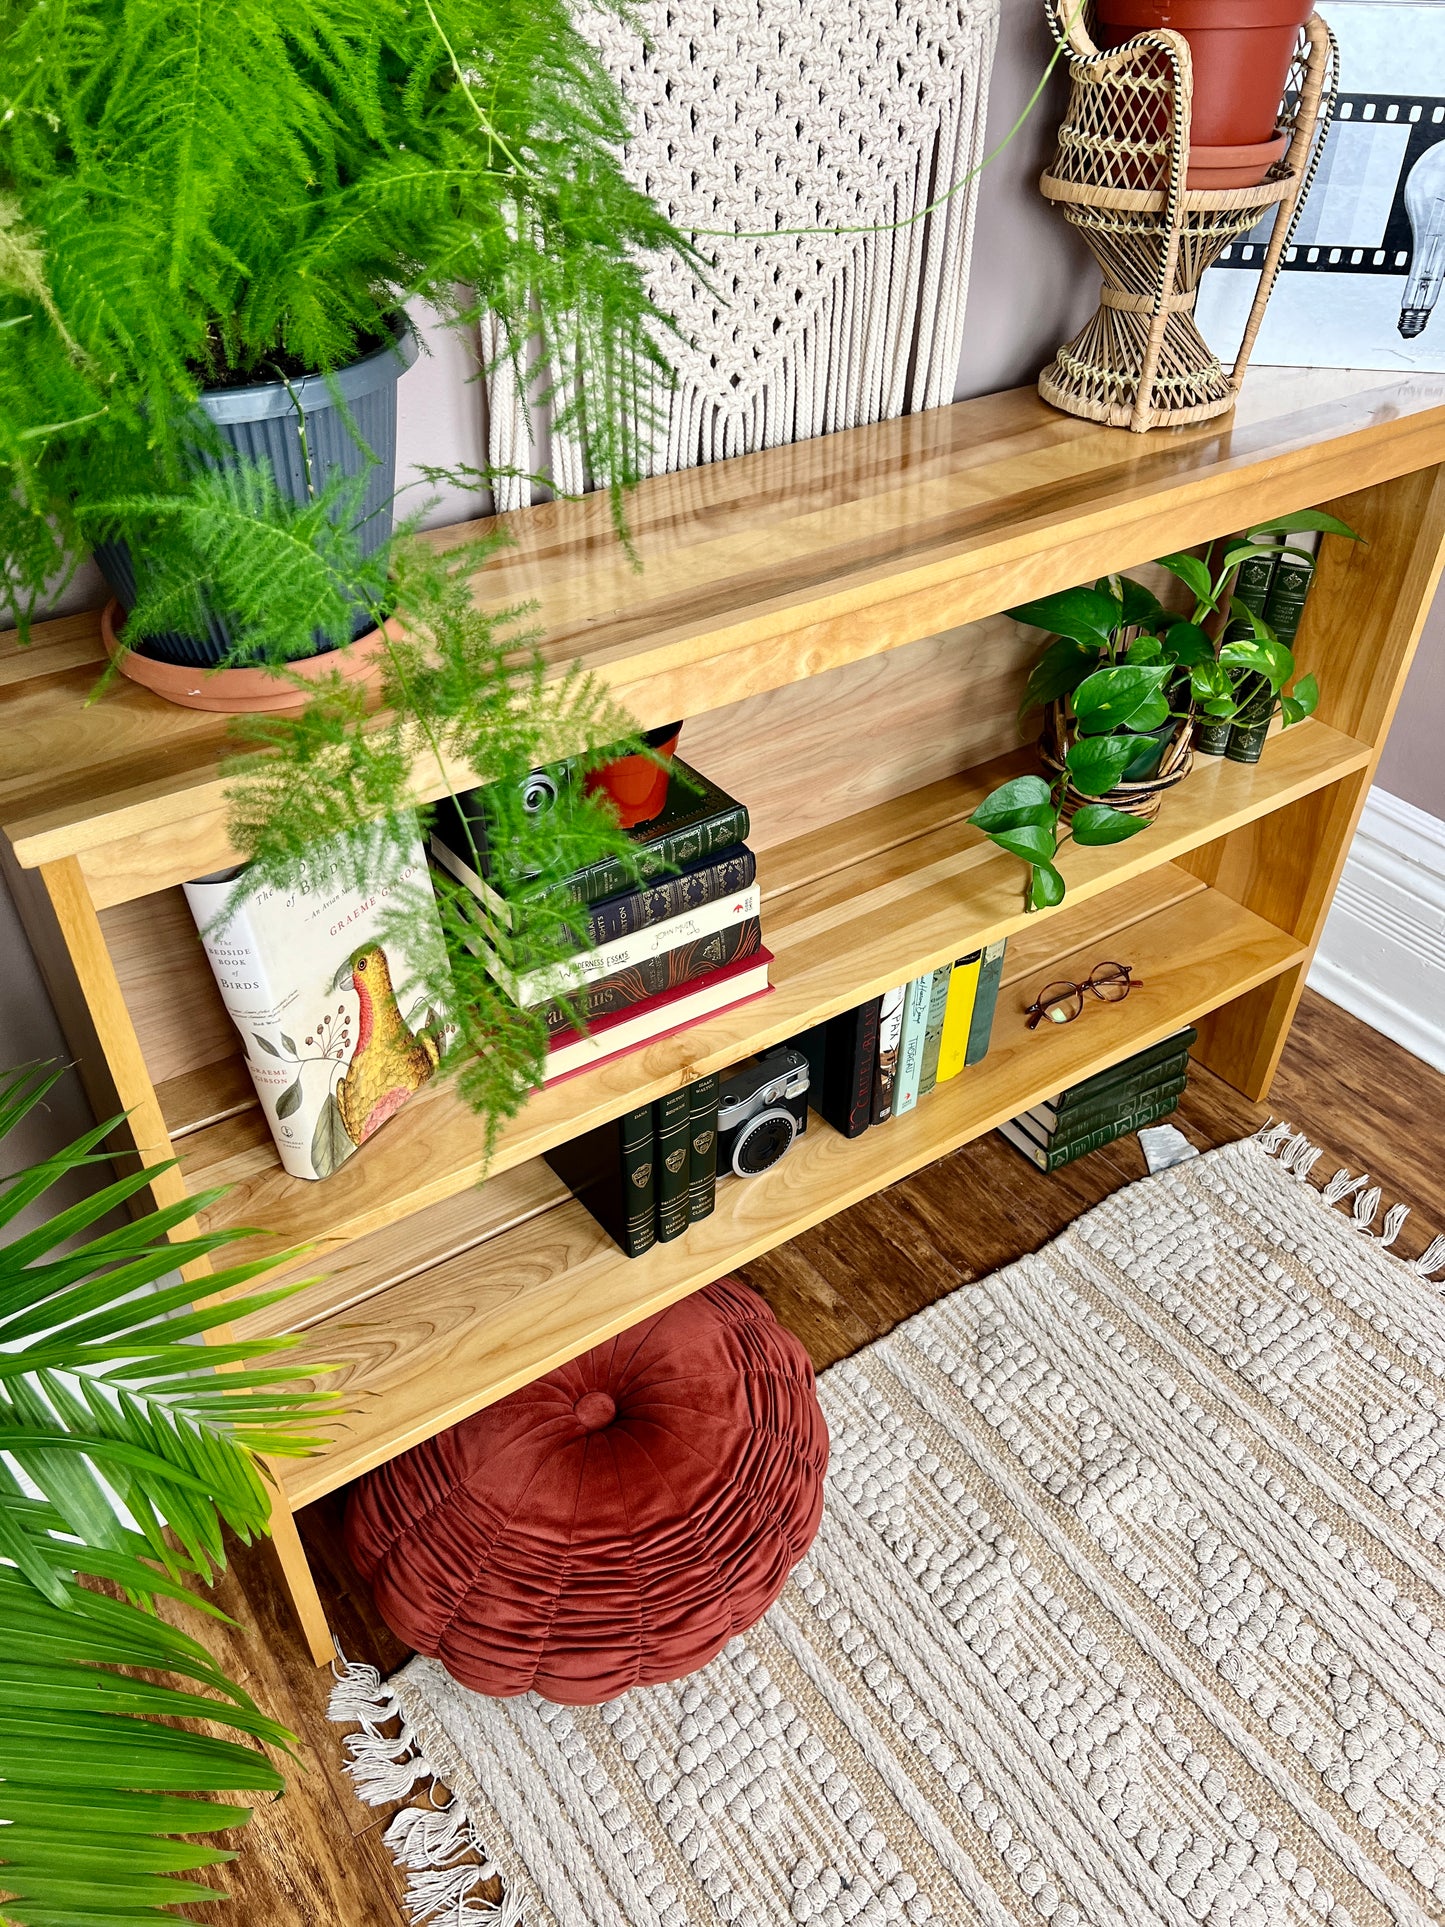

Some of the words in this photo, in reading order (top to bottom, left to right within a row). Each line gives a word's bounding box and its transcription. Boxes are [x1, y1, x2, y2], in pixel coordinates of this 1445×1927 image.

[255, 888, 273, 907] The
[280, 836, 343, 887] EDSIDE
[286, 892, 297, 908] of
[311, 908, 321, 919] An
[322, 894, 340, 912] Avian
[330, 896, 376, 937] GRAEME
[208, 948, 251, 956] BEDSIDE
[560, 958, 604, 980] WDERNESS
[606, 951, 631, 967] ESSAYS
[220, 978, 260, 990] BIRDS
[861, 1004, 876, 1053] BEAU
[890, 1014, 902, 1040] PAX
[905, 1036, 918, 1076] THOREAU
[250, 1066, 288, 1076] GRAEME
[254, 1075, 288, 1085] GIBSON
[856, 1055, 872, 1109] CRUEL
[666, 1093, 685, 1106] MILTON
